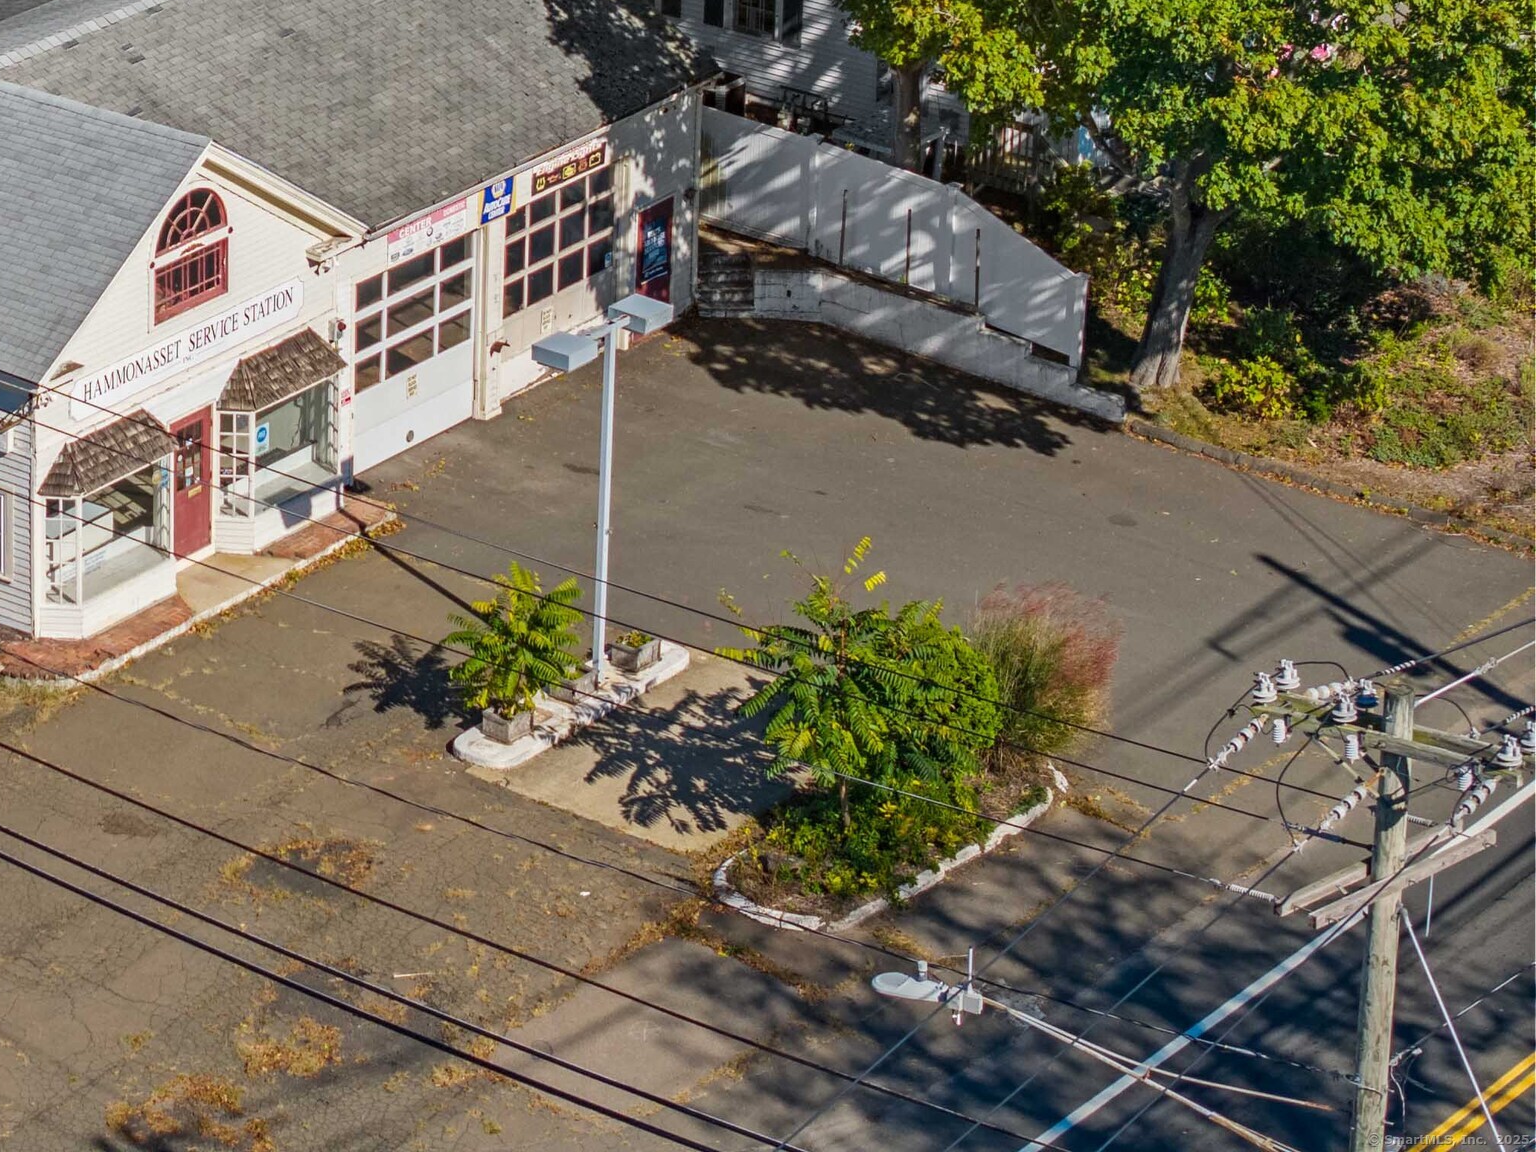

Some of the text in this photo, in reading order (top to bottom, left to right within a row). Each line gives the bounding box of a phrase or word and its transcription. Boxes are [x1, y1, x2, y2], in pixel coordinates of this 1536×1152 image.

[399, 217, 432, 238] CENTER
[83, 286, 294, 403] HAMMONASSET SERVICE STATION
